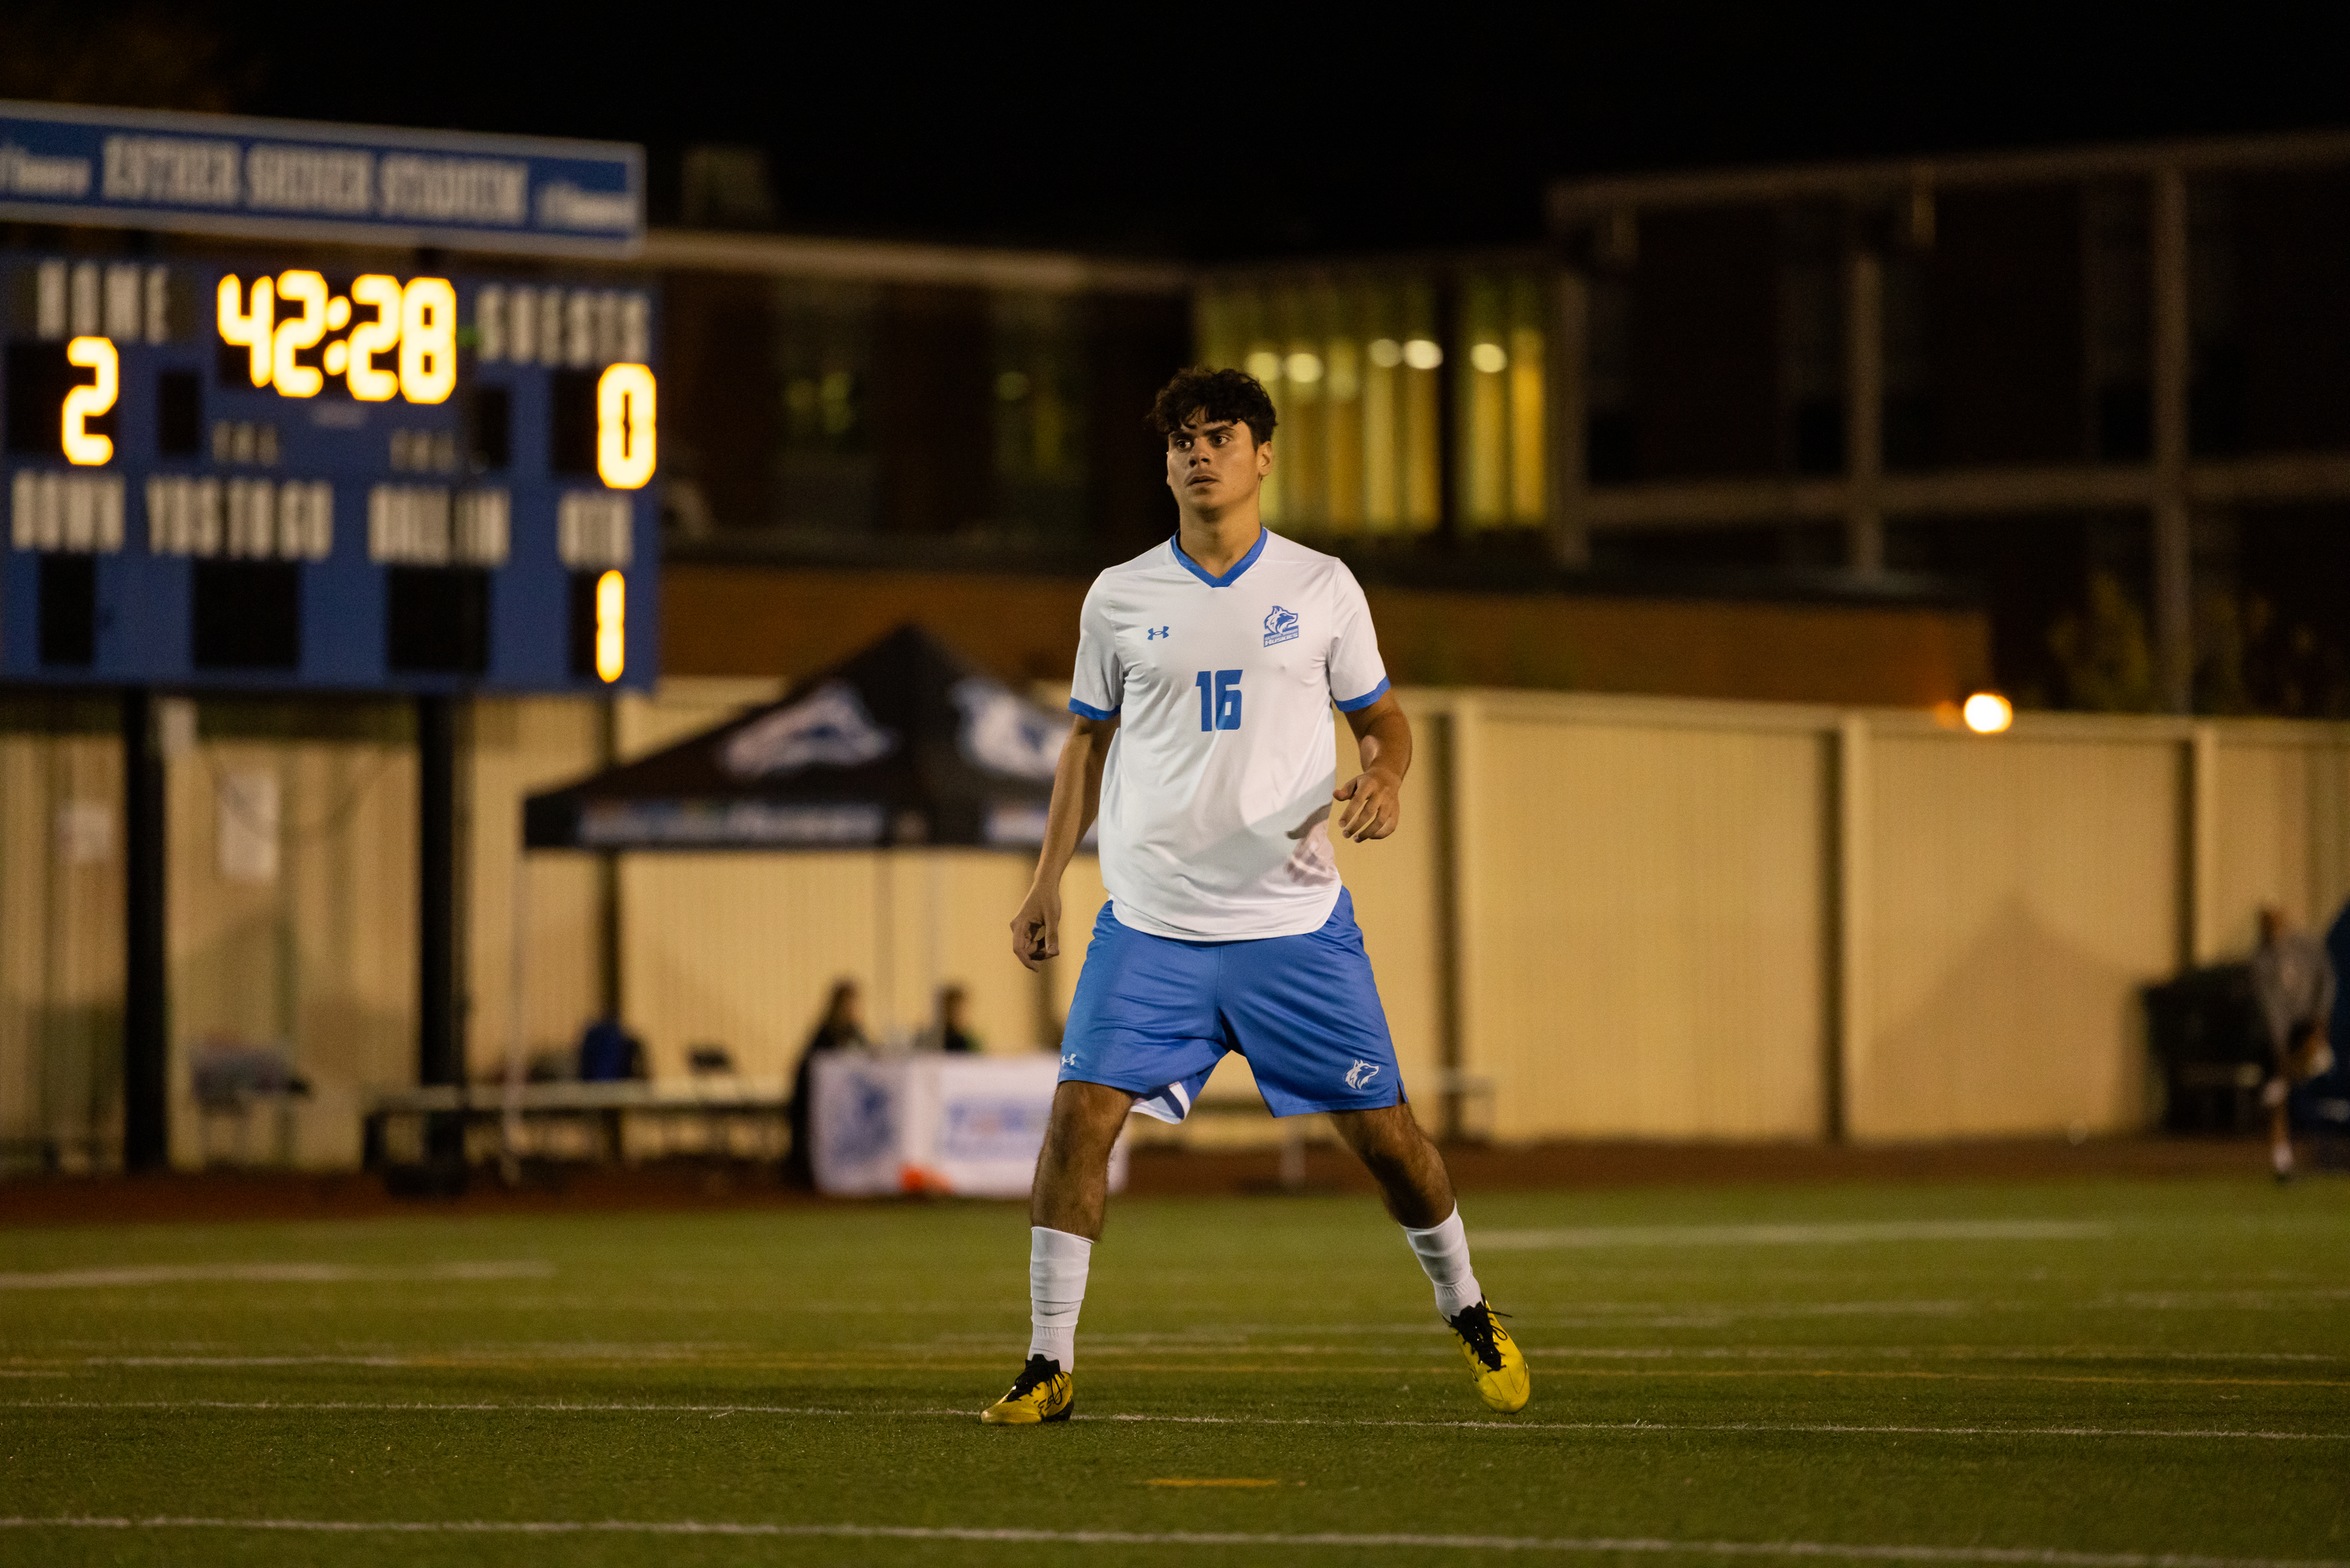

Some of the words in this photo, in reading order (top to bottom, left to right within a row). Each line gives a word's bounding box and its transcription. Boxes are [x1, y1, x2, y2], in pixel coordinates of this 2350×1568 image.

[217, 270, 456, 404] 42:28
[62, 336, 119, 466] 2
[597, 363, 656, 489] 0
[597, 570, 625, 682] 1
[1195, 669, 1243, 732] 16
